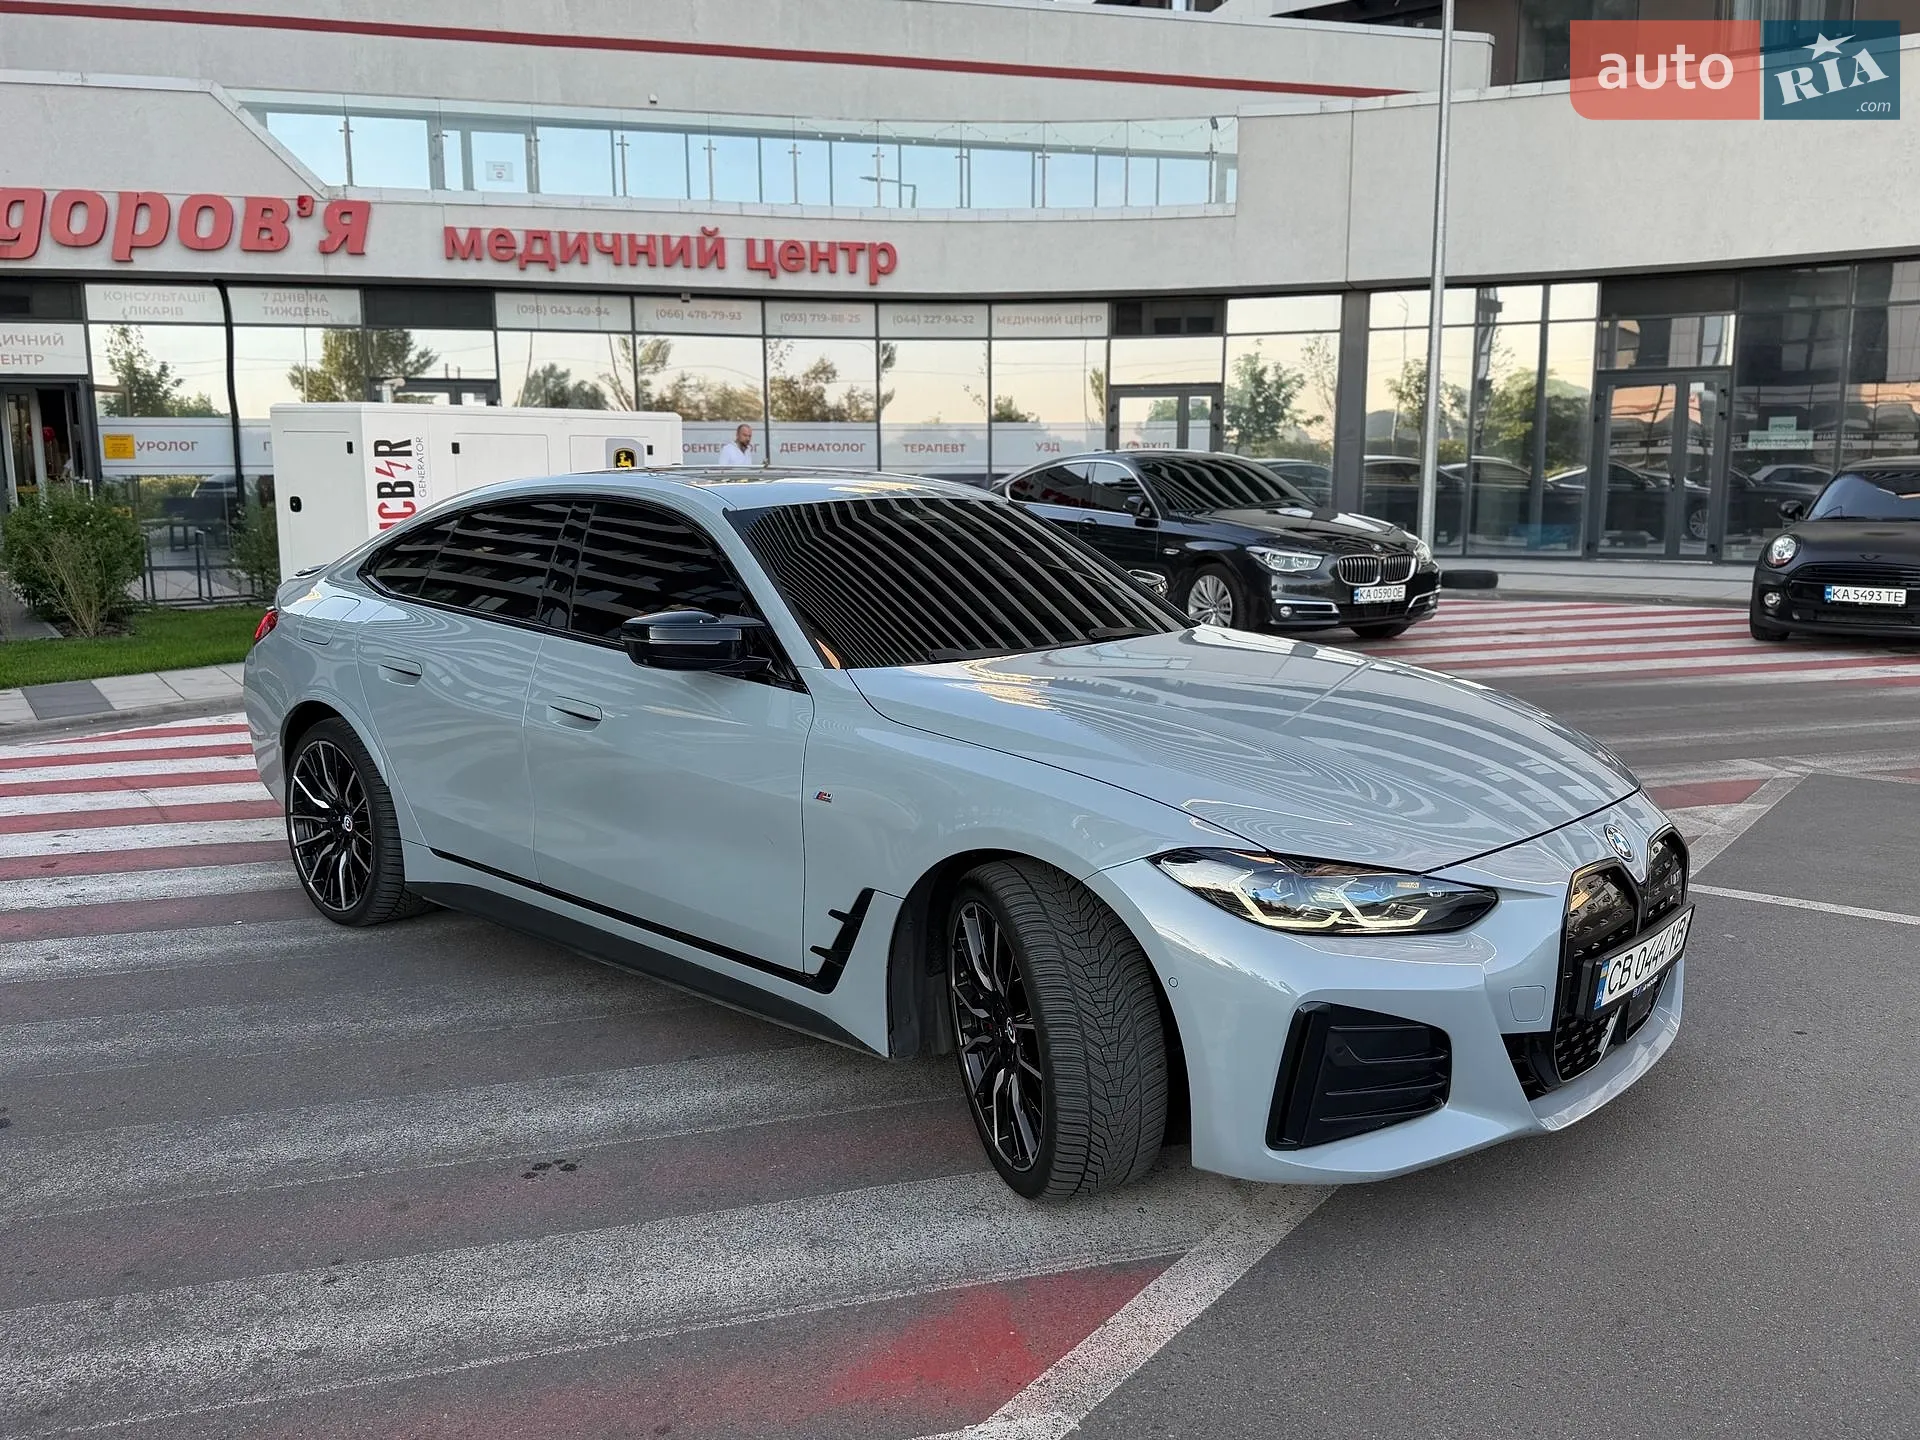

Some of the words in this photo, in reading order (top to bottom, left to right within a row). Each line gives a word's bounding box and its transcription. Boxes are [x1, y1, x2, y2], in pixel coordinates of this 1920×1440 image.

[443, 225, 726, 270] медичний
[747, 238, 898, 286] центр
[104, 290, 206, 304] КОНСУЛЬТАЦІЇ
[272, 292, 305, 303] ДНІВ
[309, 293, 328, 303] НА
[128, 305, 184, 317] ЛІКАРІВ
[262, 306, 330, 317] ТИЖДЕНЬ
[997, 312, 1062, 326] МЕДИЧНИЙ
[1065, 314, 1103, 327] ЦЕНТР
[0, 332, 64, 347] ИЧНИЙ
[136, 440, 199, 452] УРОЛОГ
[779, 442, 866, 454] ДЕРМАТОЛОГ
[903, 442, 966, 454] ТЕРАПЕВТ
[1035, 442, 1061, 453] УЗД
[415, 436, 427, 498] GENERATOR
[1832, 588, 1850, 600] KA
[1853, 589, 1882, 602] 5493
[1885, 590, 1904, 603] TE
[1608, 953, 1633, 995] CB
[1634, 929, 1671, 980] 0444
